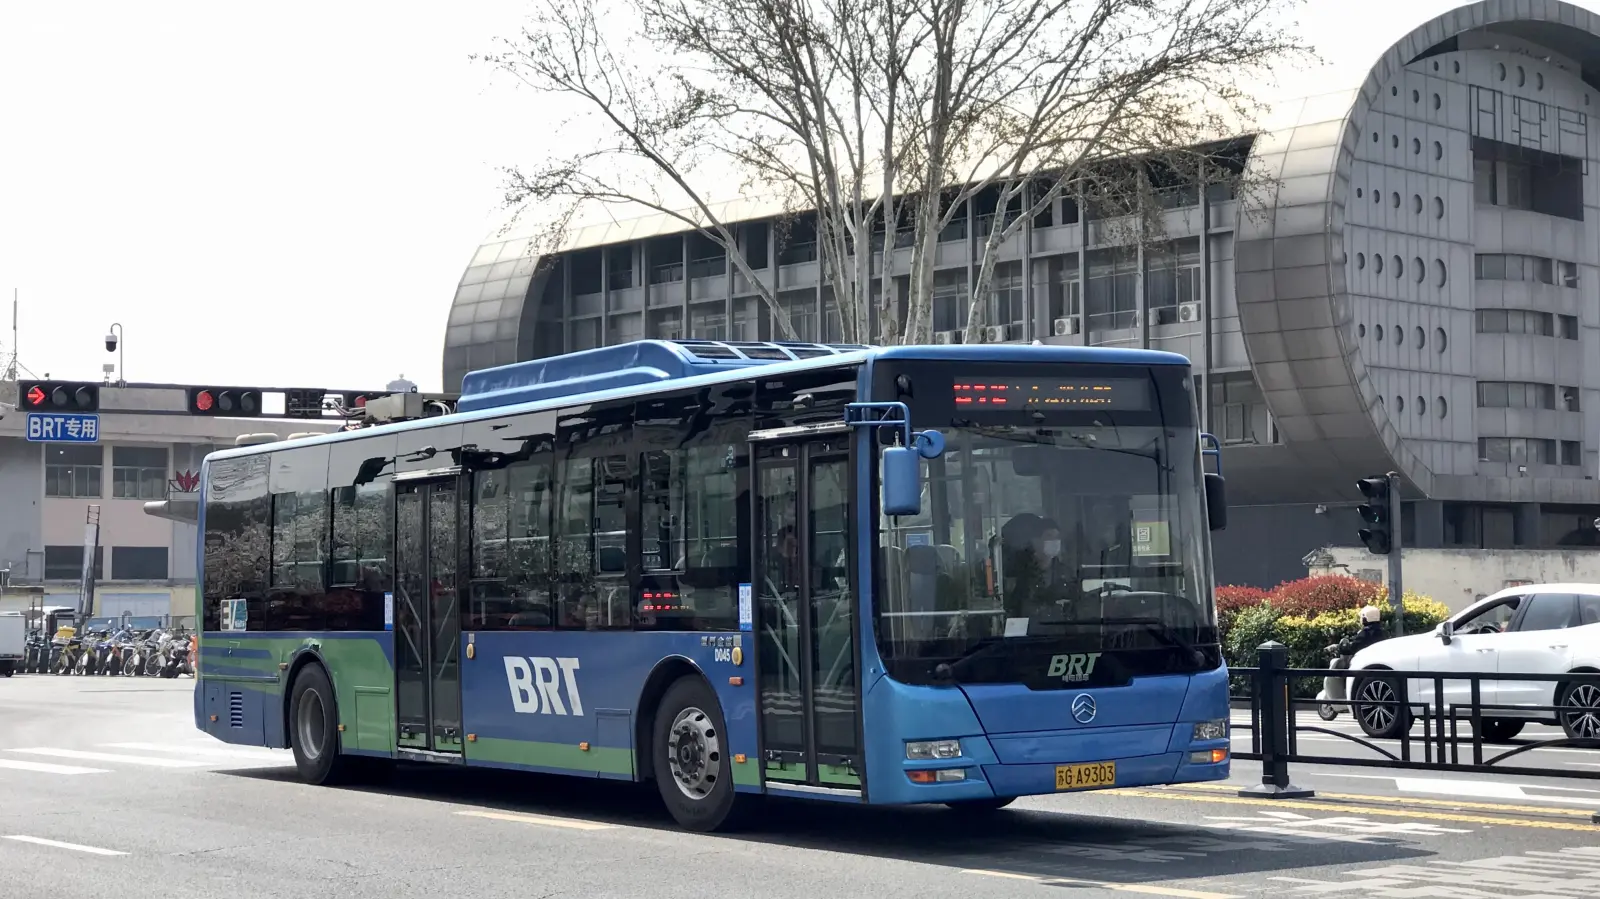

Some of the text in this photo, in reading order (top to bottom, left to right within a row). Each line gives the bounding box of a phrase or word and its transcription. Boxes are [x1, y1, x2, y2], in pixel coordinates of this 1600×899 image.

[29, 417, 96, 438] BRT专用
[715, 648, 730, 662] D045
[1047, 652, 1103, 676] BRT
[503, 656, 584, 717] BRT
